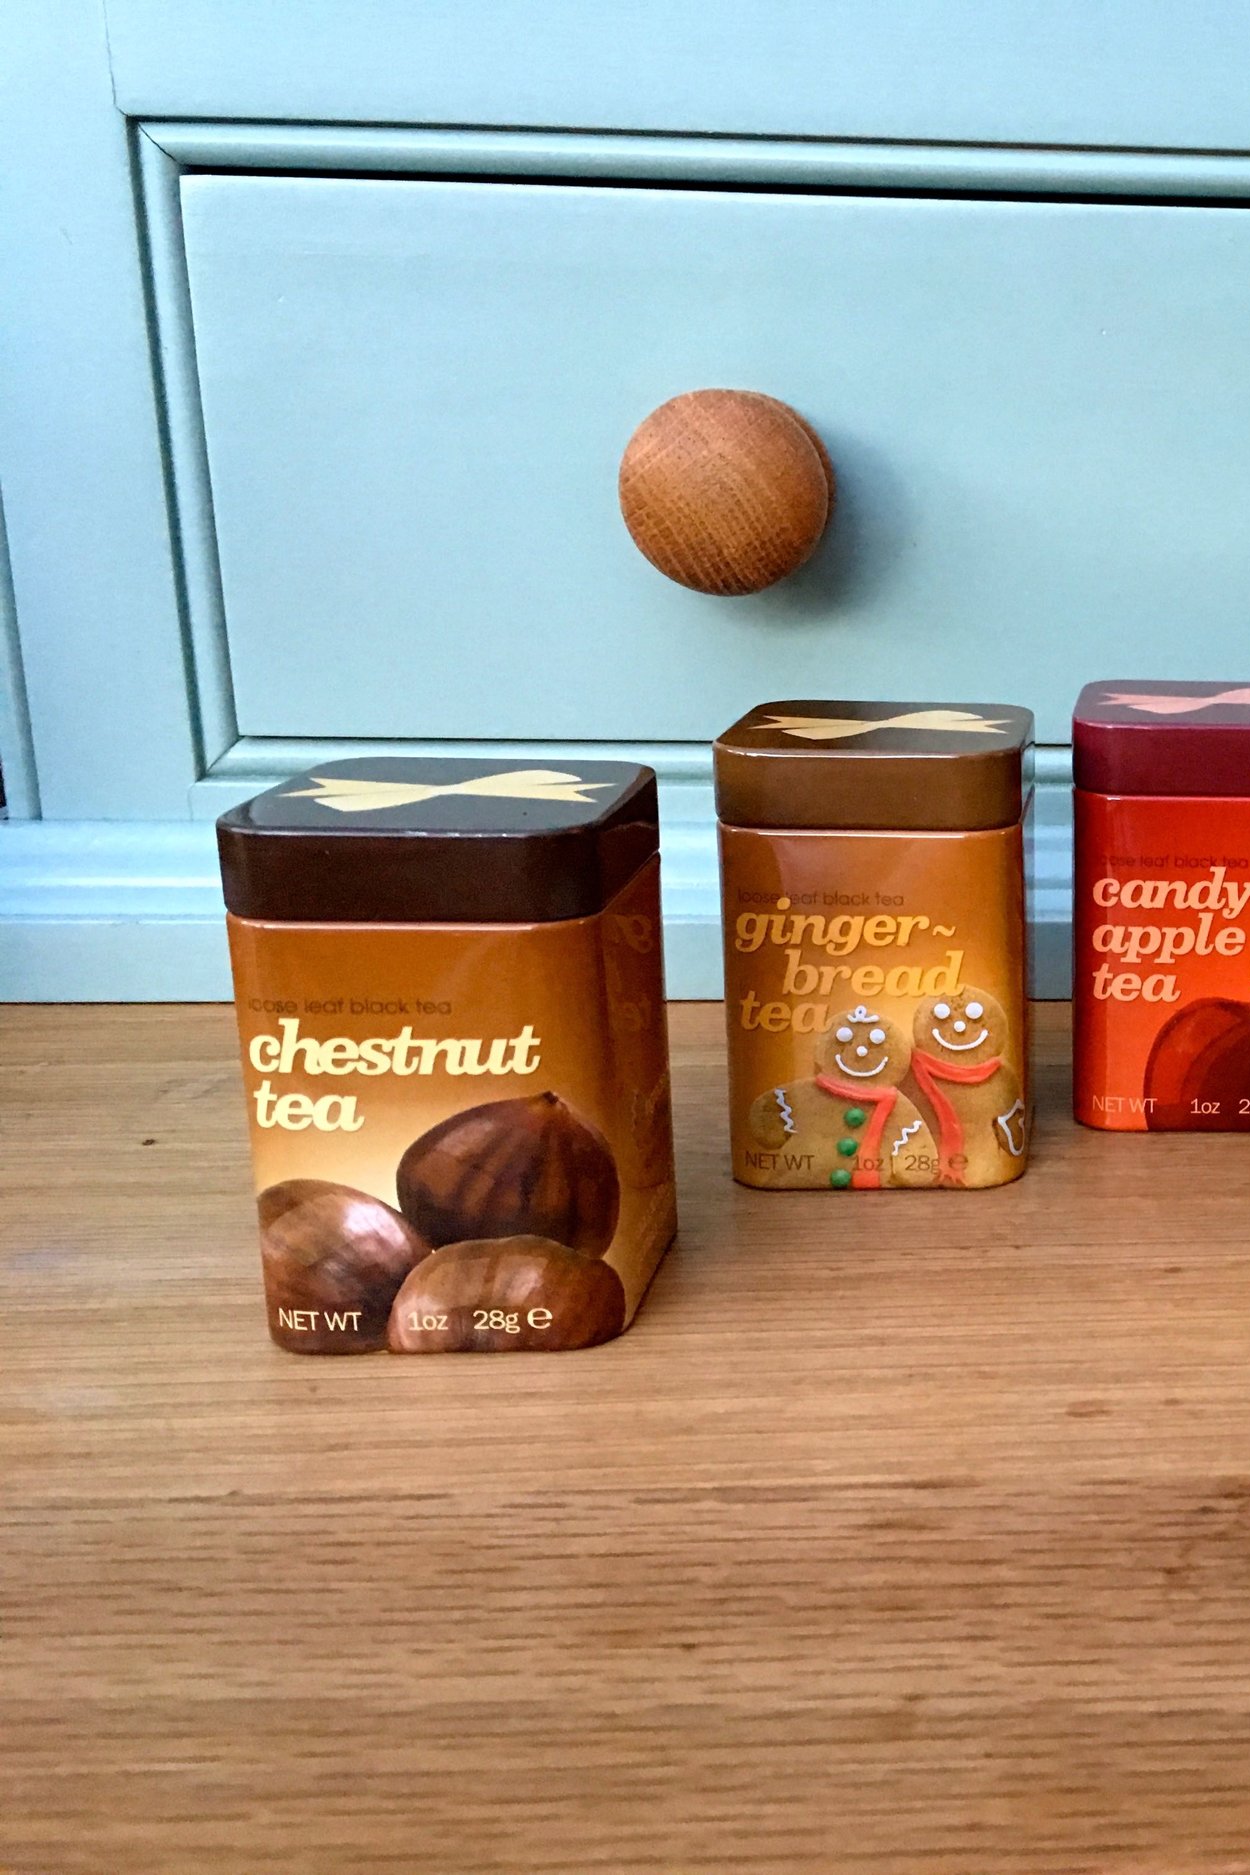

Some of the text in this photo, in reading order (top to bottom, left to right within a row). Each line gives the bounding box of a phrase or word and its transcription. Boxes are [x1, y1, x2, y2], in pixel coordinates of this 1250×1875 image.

[1140, 855, 1169, 867] leaf
[738, 889, 781, 904] loose
[823, 891, 870, 906] black
[875, 892, 904, 906] tea
[1092, 913, 1246, 964] apple
[782, 949, 965, 997] bread
[1092, 963, 1180, 1002] tea
[304, 998, 344, 1014] leaf
[350, 999, 409, 1015] black
[416, 999, 452, 1014] tea
[740, 990, 833, 1034] tea
[249, 1018, 541, 1076] chestnut
[253, 1079, 365, 1132] tea
[1092, 1095, 1125, 1112] NET
[1129, 1098, 1157, 1113] WT
[1190, 1099, 1220, 1114] 1oz
[745, 1151, 779, 1170] NET
[784, 1154, 814, 1170] WT
[278, 1308, 319, 1331] NET
[324, 1311, 362, 1331] WT
[407, 1312, 448, 1331] 1oz
[473, 1310, 521, 1333] 28g
